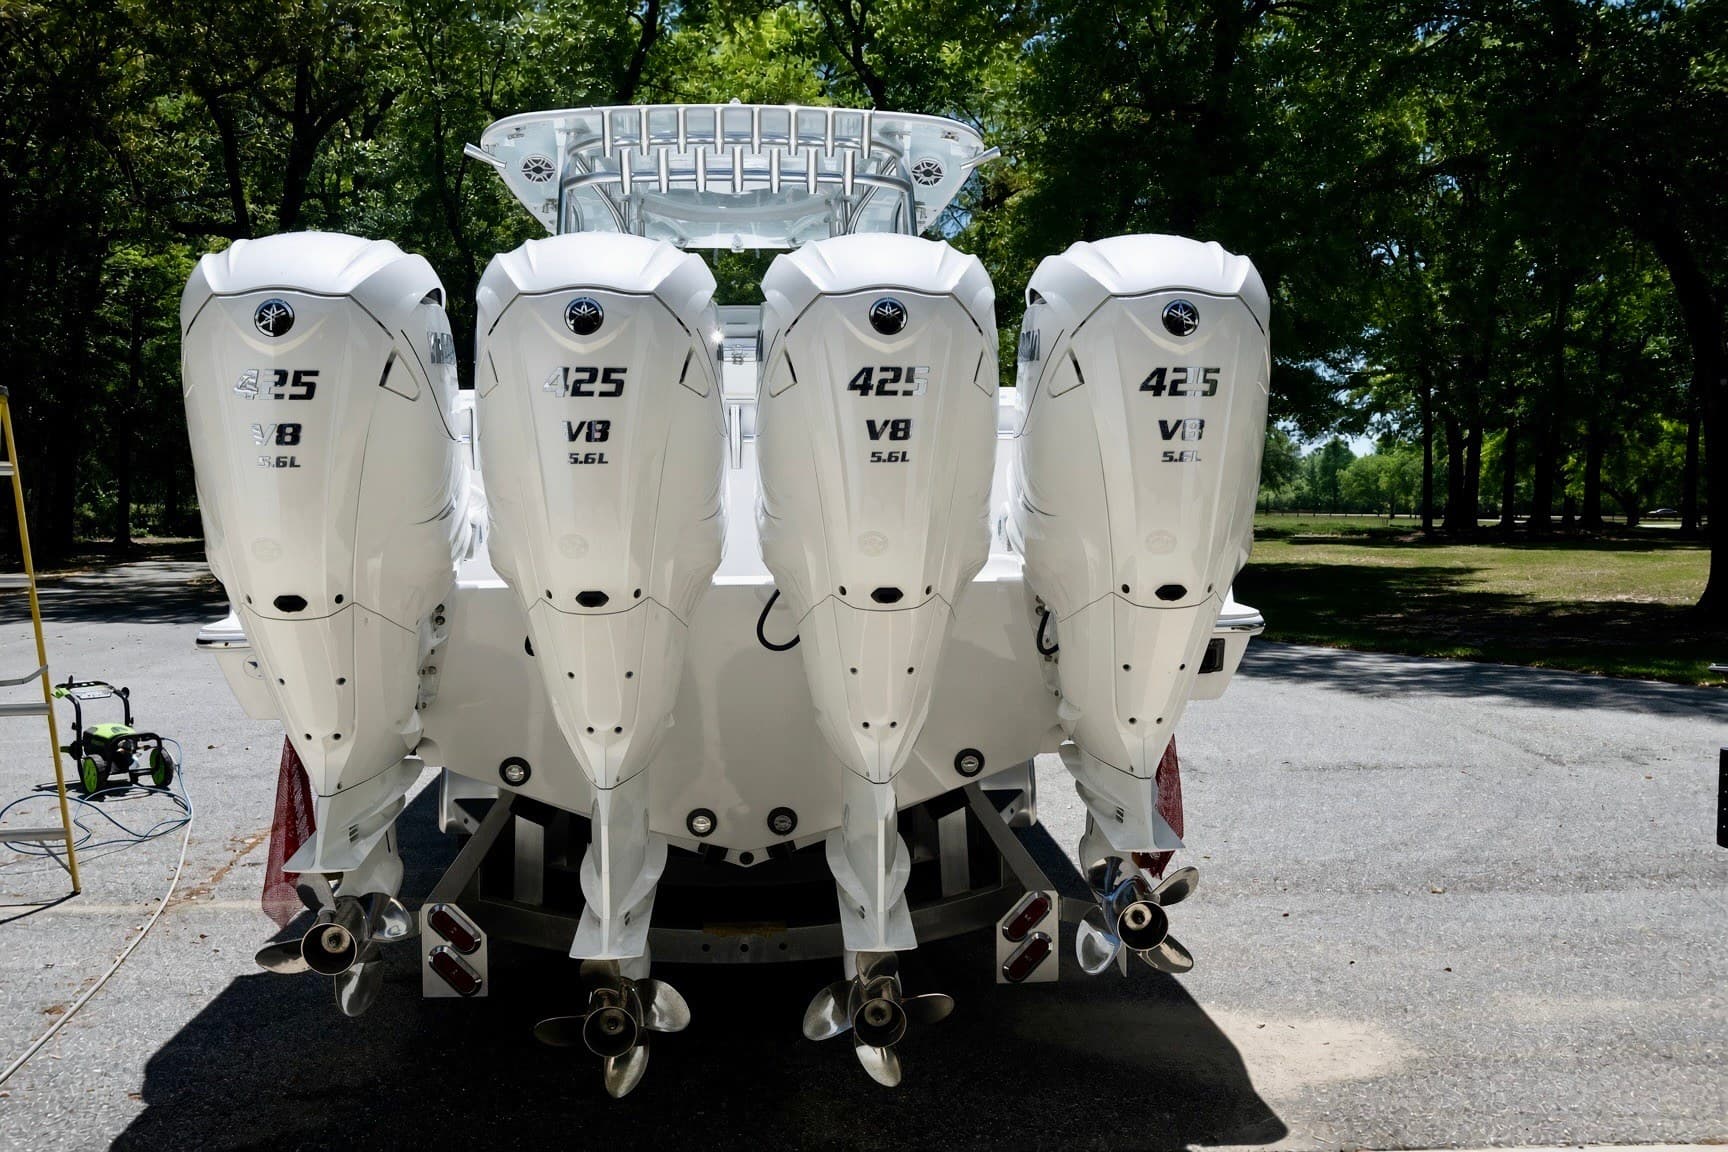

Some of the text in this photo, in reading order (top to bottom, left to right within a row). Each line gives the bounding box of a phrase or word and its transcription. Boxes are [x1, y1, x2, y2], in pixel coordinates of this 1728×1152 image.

[233, 368, 320, 401] 425
[542, 367, 628, 398] 425
[847, 366, 930, 397] 425
[1139, 367, 1220, 397] 425
[250, 423, 303, 446] V8
[561, 420, 611, 442] V8
[865, 419, 912, 440] V8
[1158, 419, 1205, 441] V8
[568, 452, 609, 464] 5.6L
[870, 450, 910, 463] 5.6L
